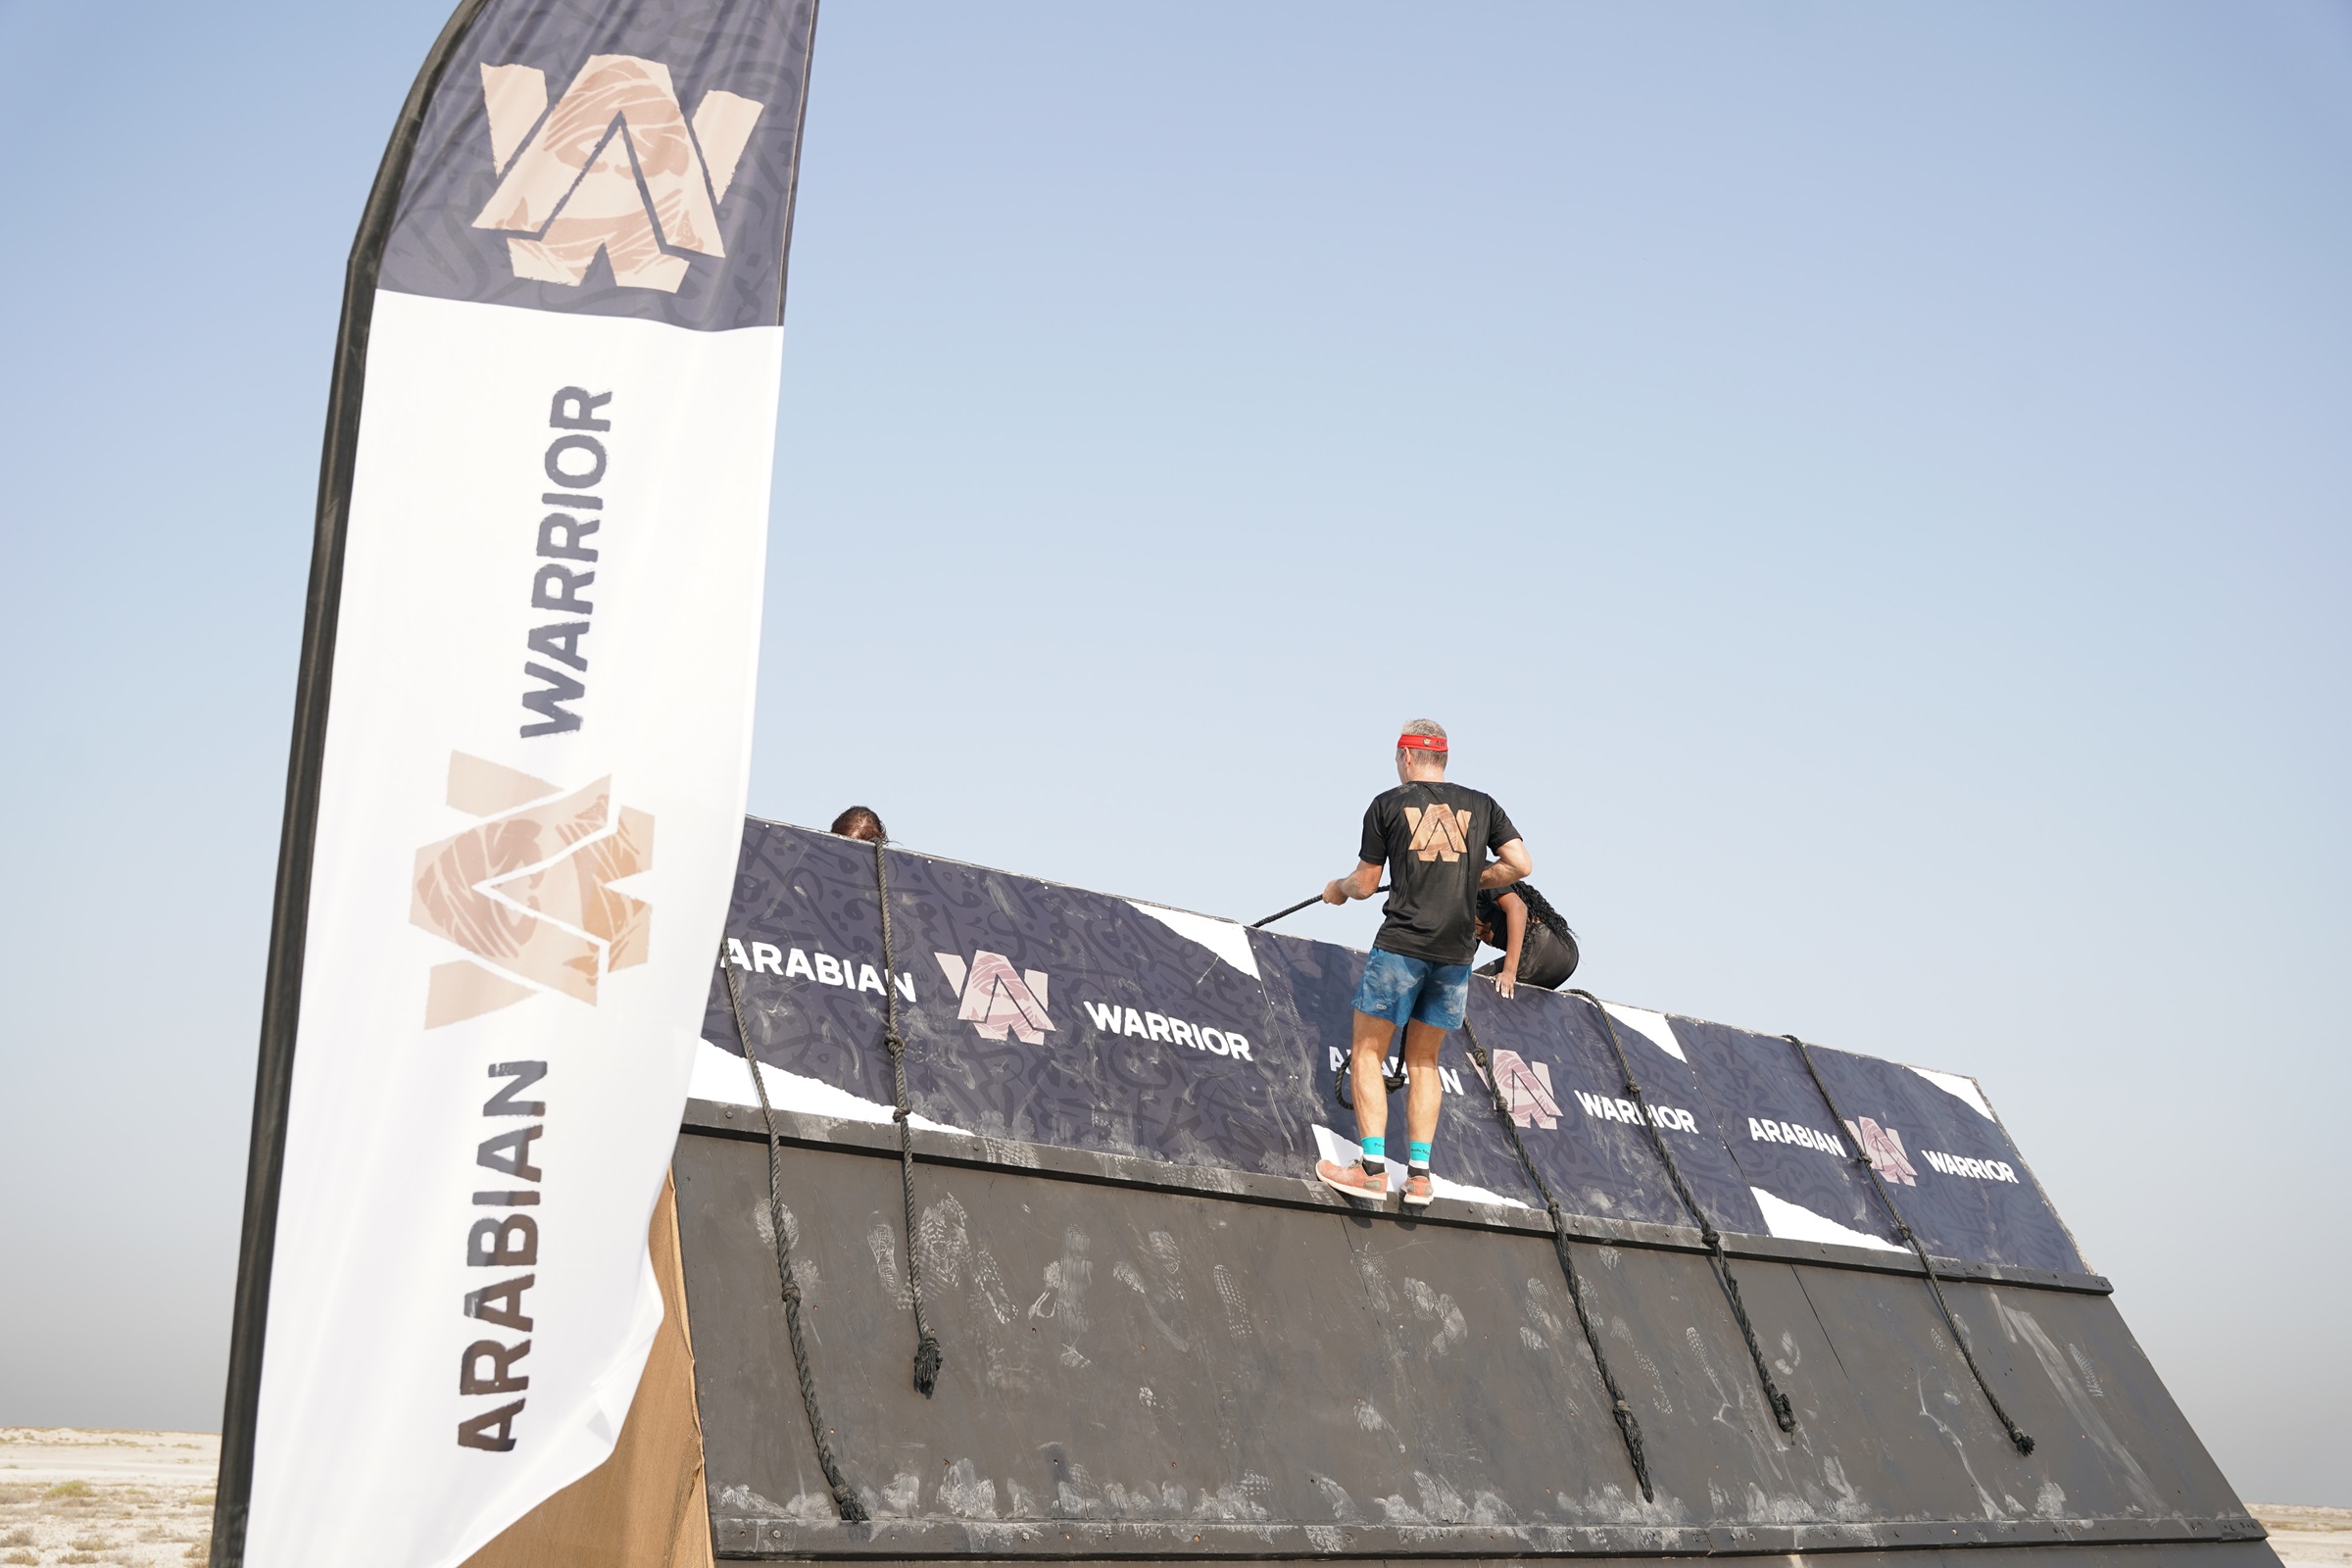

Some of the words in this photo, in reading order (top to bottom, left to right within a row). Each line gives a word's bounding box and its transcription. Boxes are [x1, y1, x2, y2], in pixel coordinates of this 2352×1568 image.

[458, 1060, 549, 1452] ARABIAN
[519, 385, 612, 739] WARRIOR
[720, 937, 916, 1003] ARABIAN
[1083, 1001, 1253, 1061] WARRIOR
[1748, 1117, 1846, 1157] ARABIAN
[1922, 1150, 2019, 1184] WARRIOR
